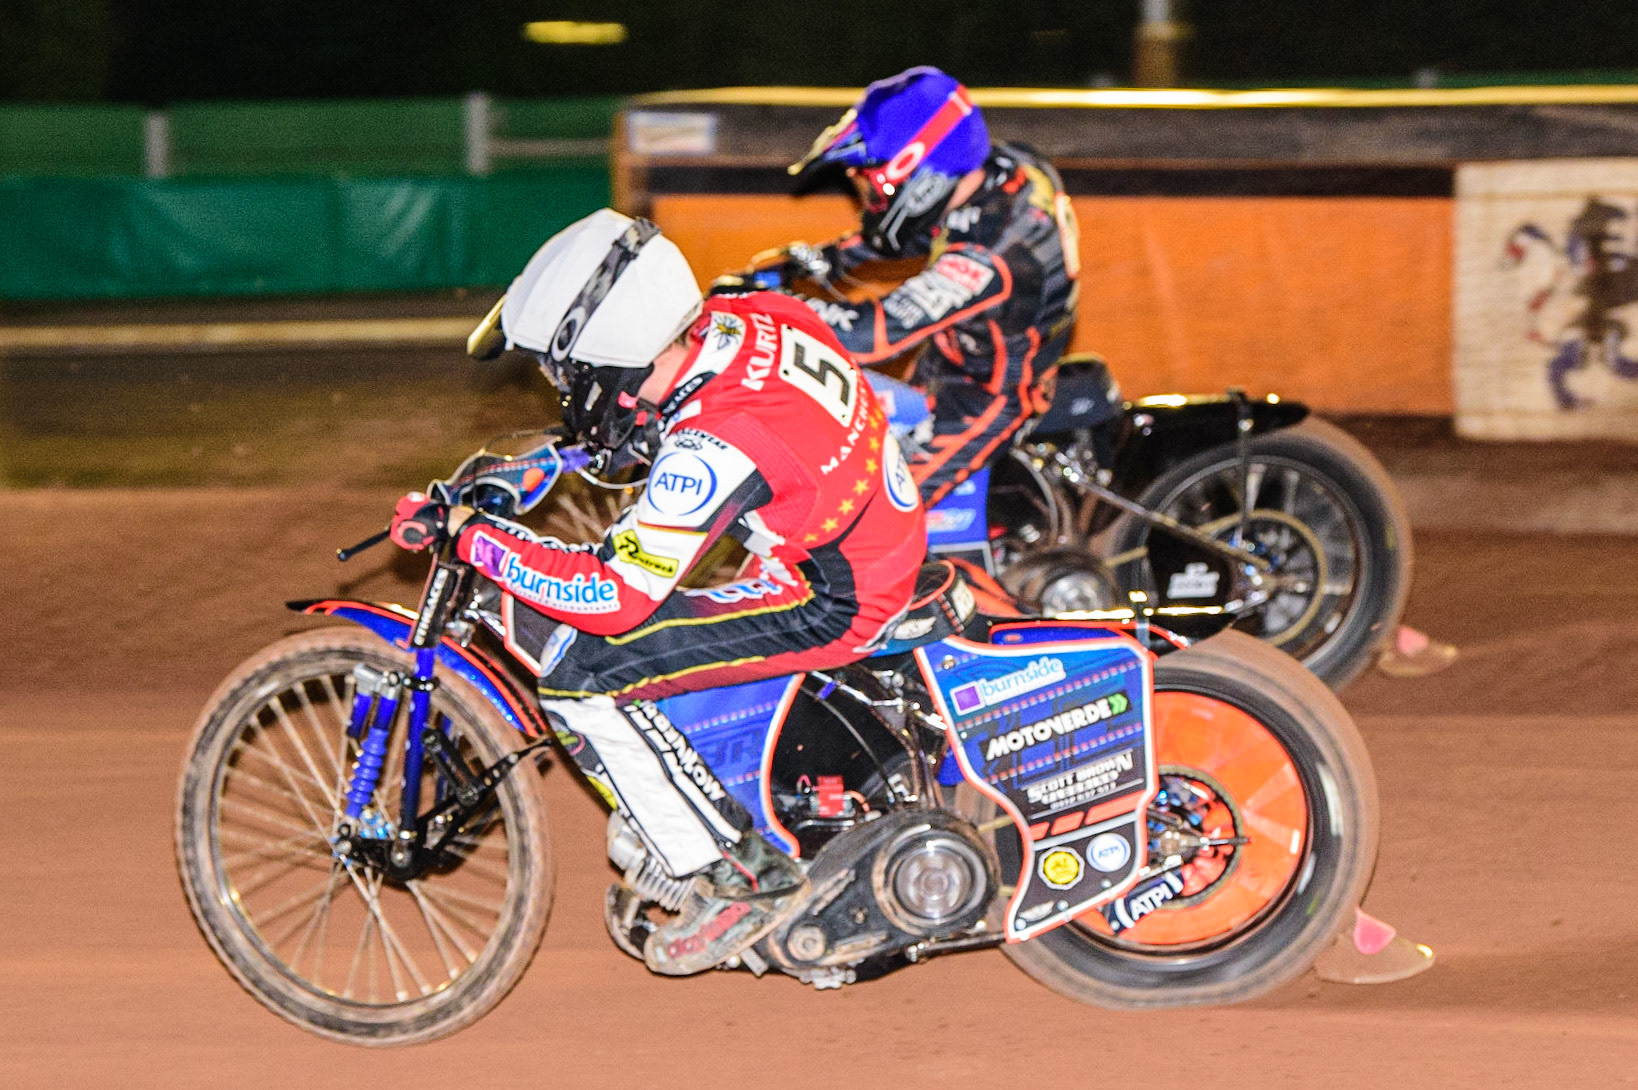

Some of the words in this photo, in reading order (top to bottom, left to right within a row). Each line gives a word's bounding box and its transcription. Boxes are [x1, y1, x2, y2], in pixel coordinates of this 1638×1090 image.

[741, 312, 777, 391] KURTZ
[793, 340, 850, 407] 5
[654, 471, 703, 496] ATPI
[507, 556, 615, 604] burnside
[981, 657, 1061, 698] burnside
[985, 697, 1113, 762] MOTOVERDE
[1129, 881, 1174, 922] ATPI
